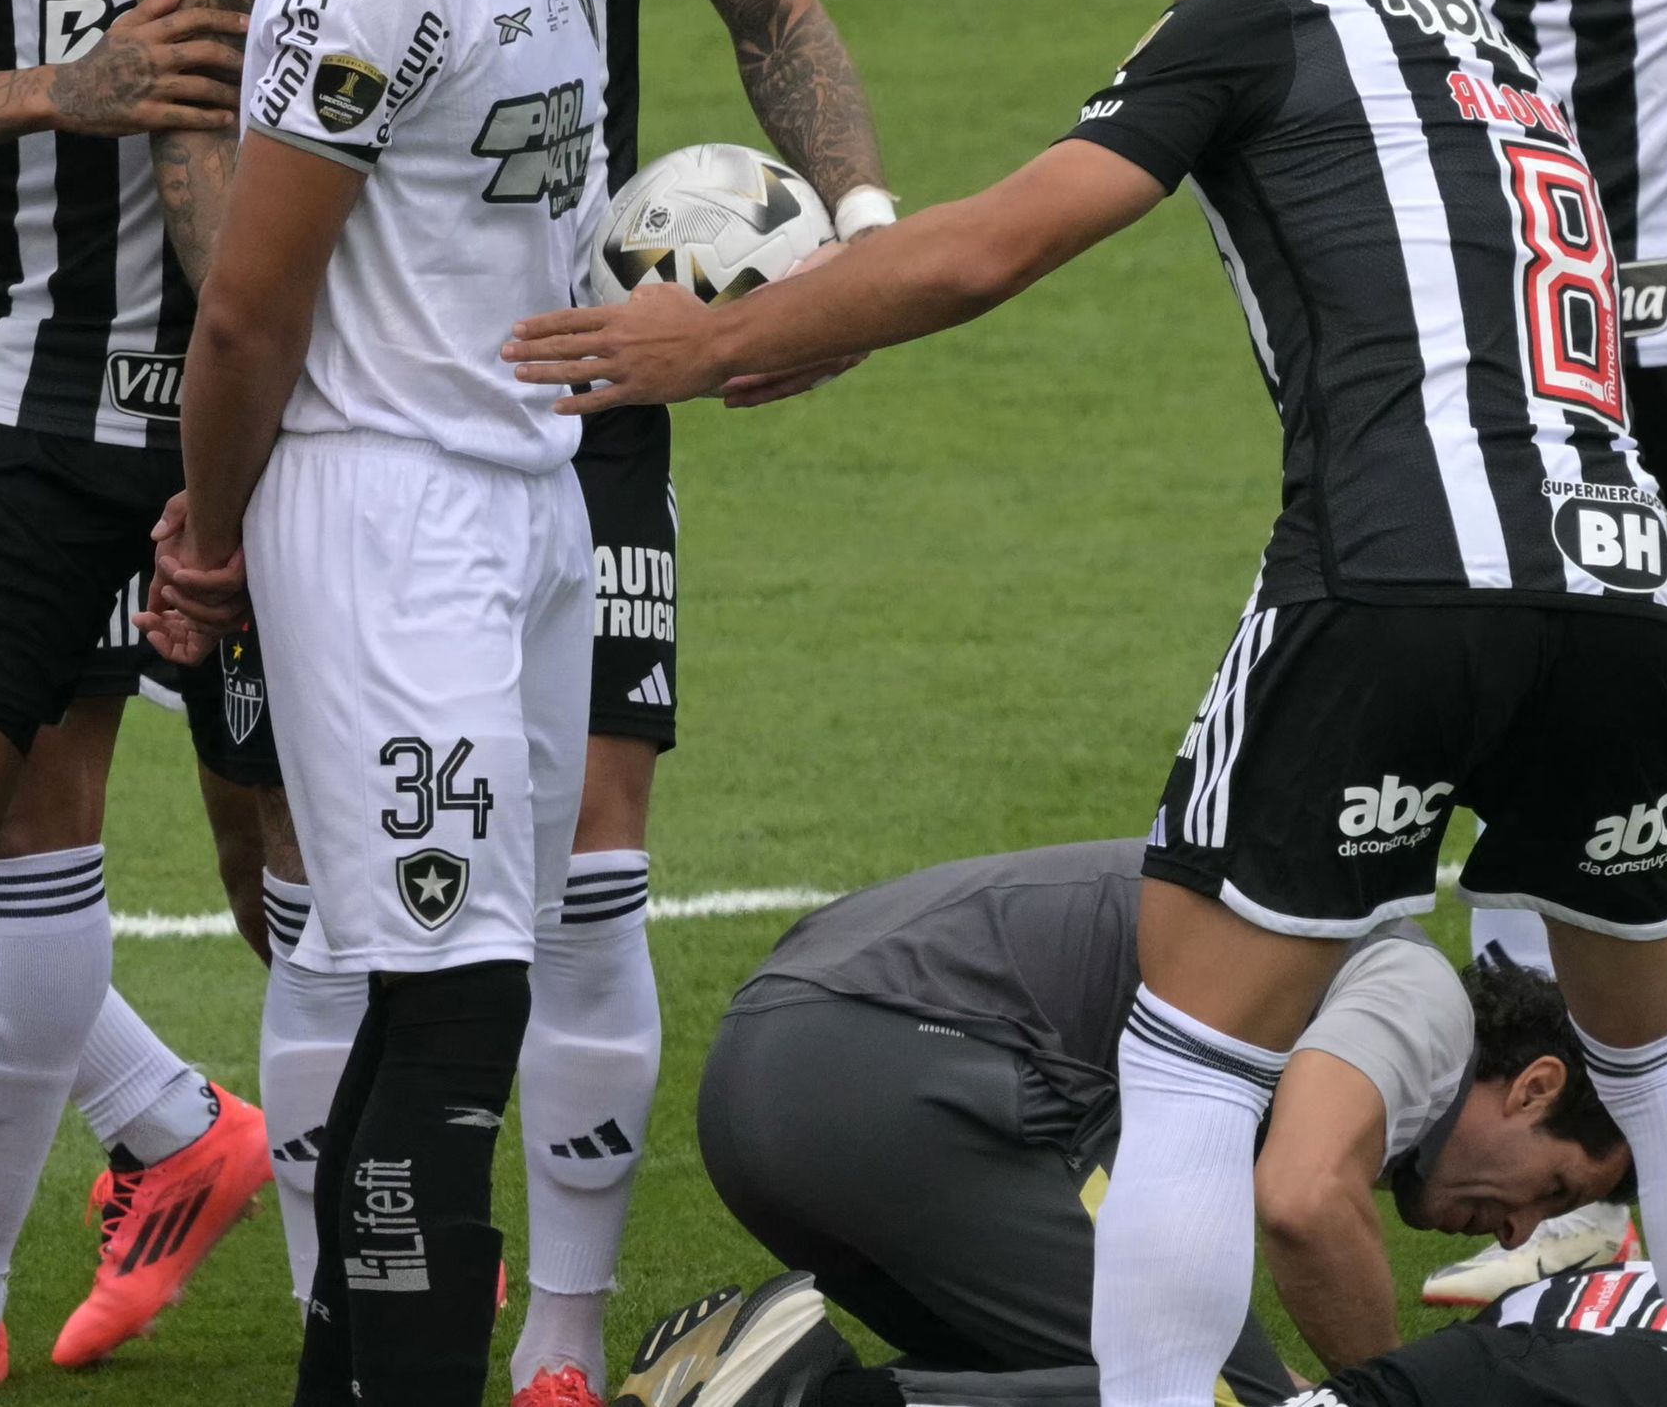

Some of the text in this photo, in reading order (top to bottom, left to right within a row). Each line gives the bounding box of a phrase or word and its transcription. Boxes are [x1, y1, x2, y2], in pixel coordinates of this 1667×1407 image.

[1502, 141, 1629, 428] 8
[594, 546, 674, 601] AUTO
[1578, 509, 1662, 576] BH
[379, 736, 494, 840] 34
[1338, 775, 1454, 837] abc
[1338, 839, 1358, 857] da
[1578, 860, 1601, 876] da
[353, 1157, 425, 1258] Lifefit
